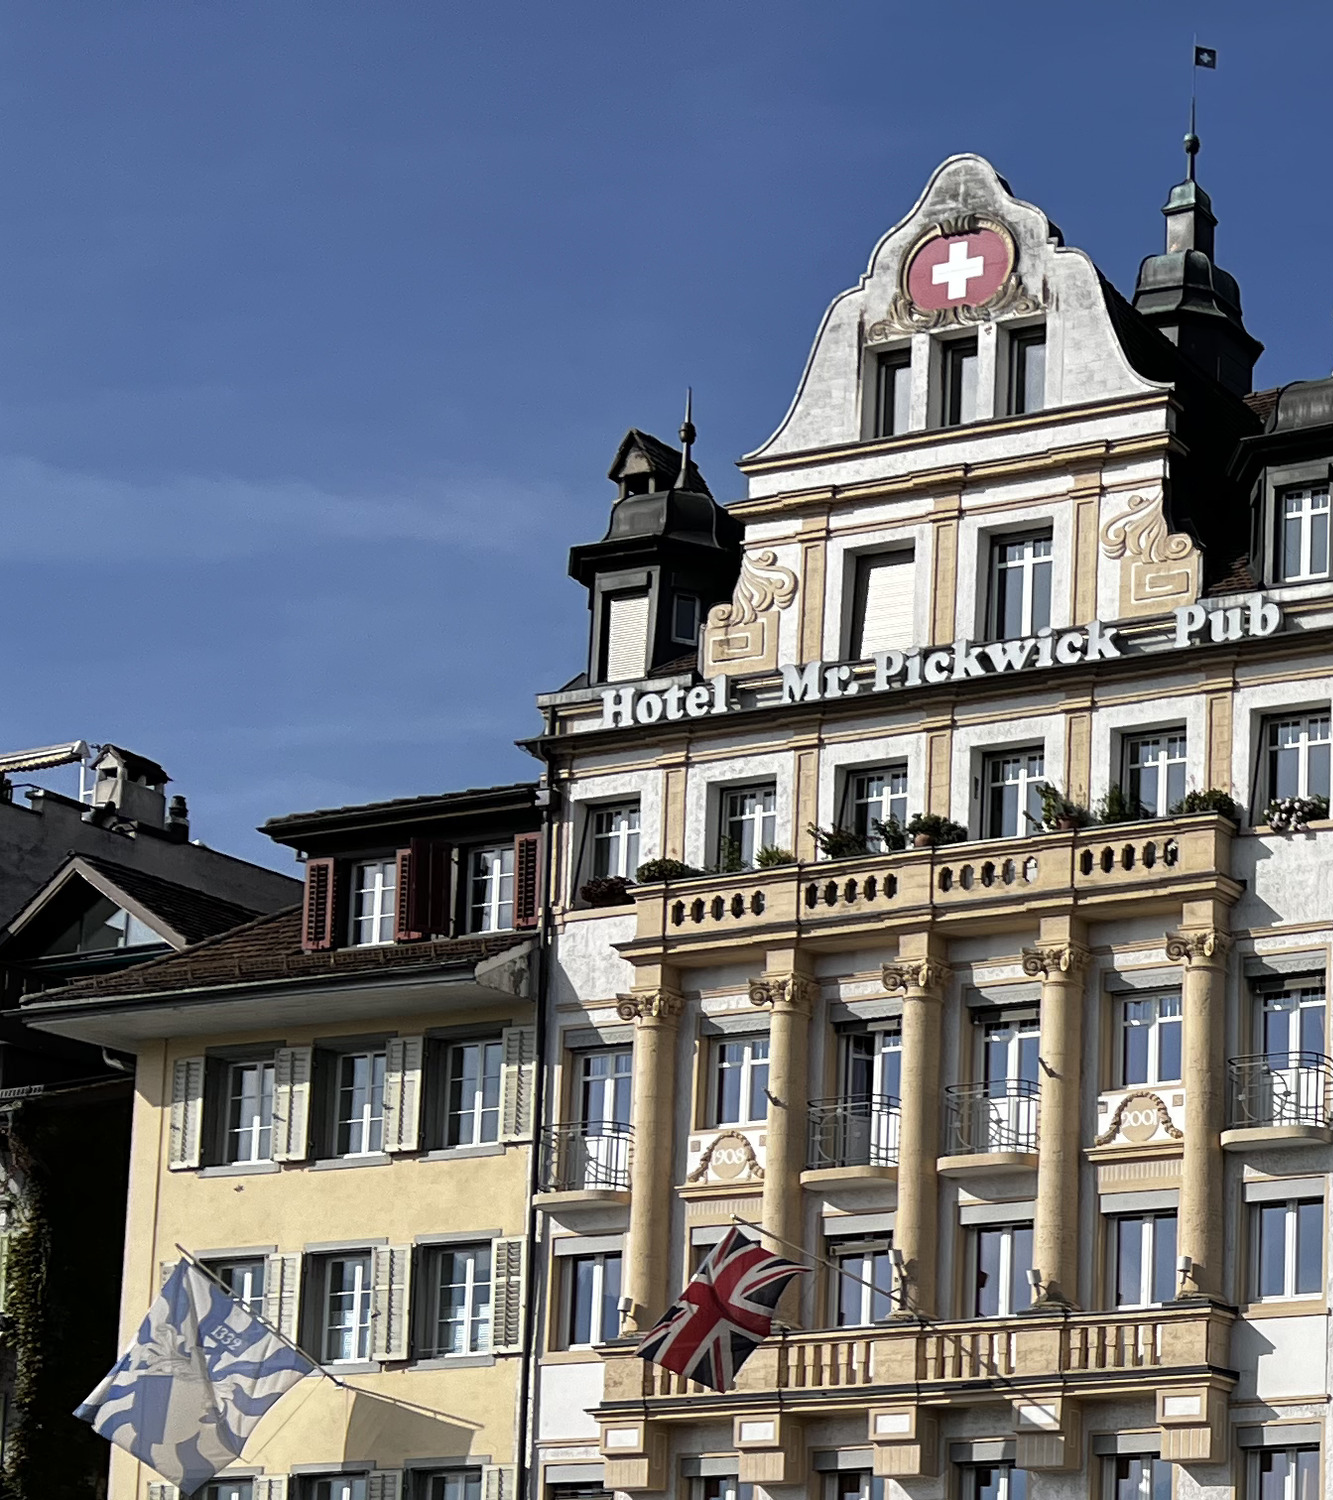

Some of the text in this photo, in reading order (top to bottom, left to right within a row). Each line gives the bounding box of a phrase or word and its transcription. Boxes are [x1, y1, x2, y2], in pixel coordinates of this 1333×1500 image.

[601, 594, 1284, 728] Hotel Mr. Pickwick Pub
[1121, 1108, 1158, 1129] 2001
